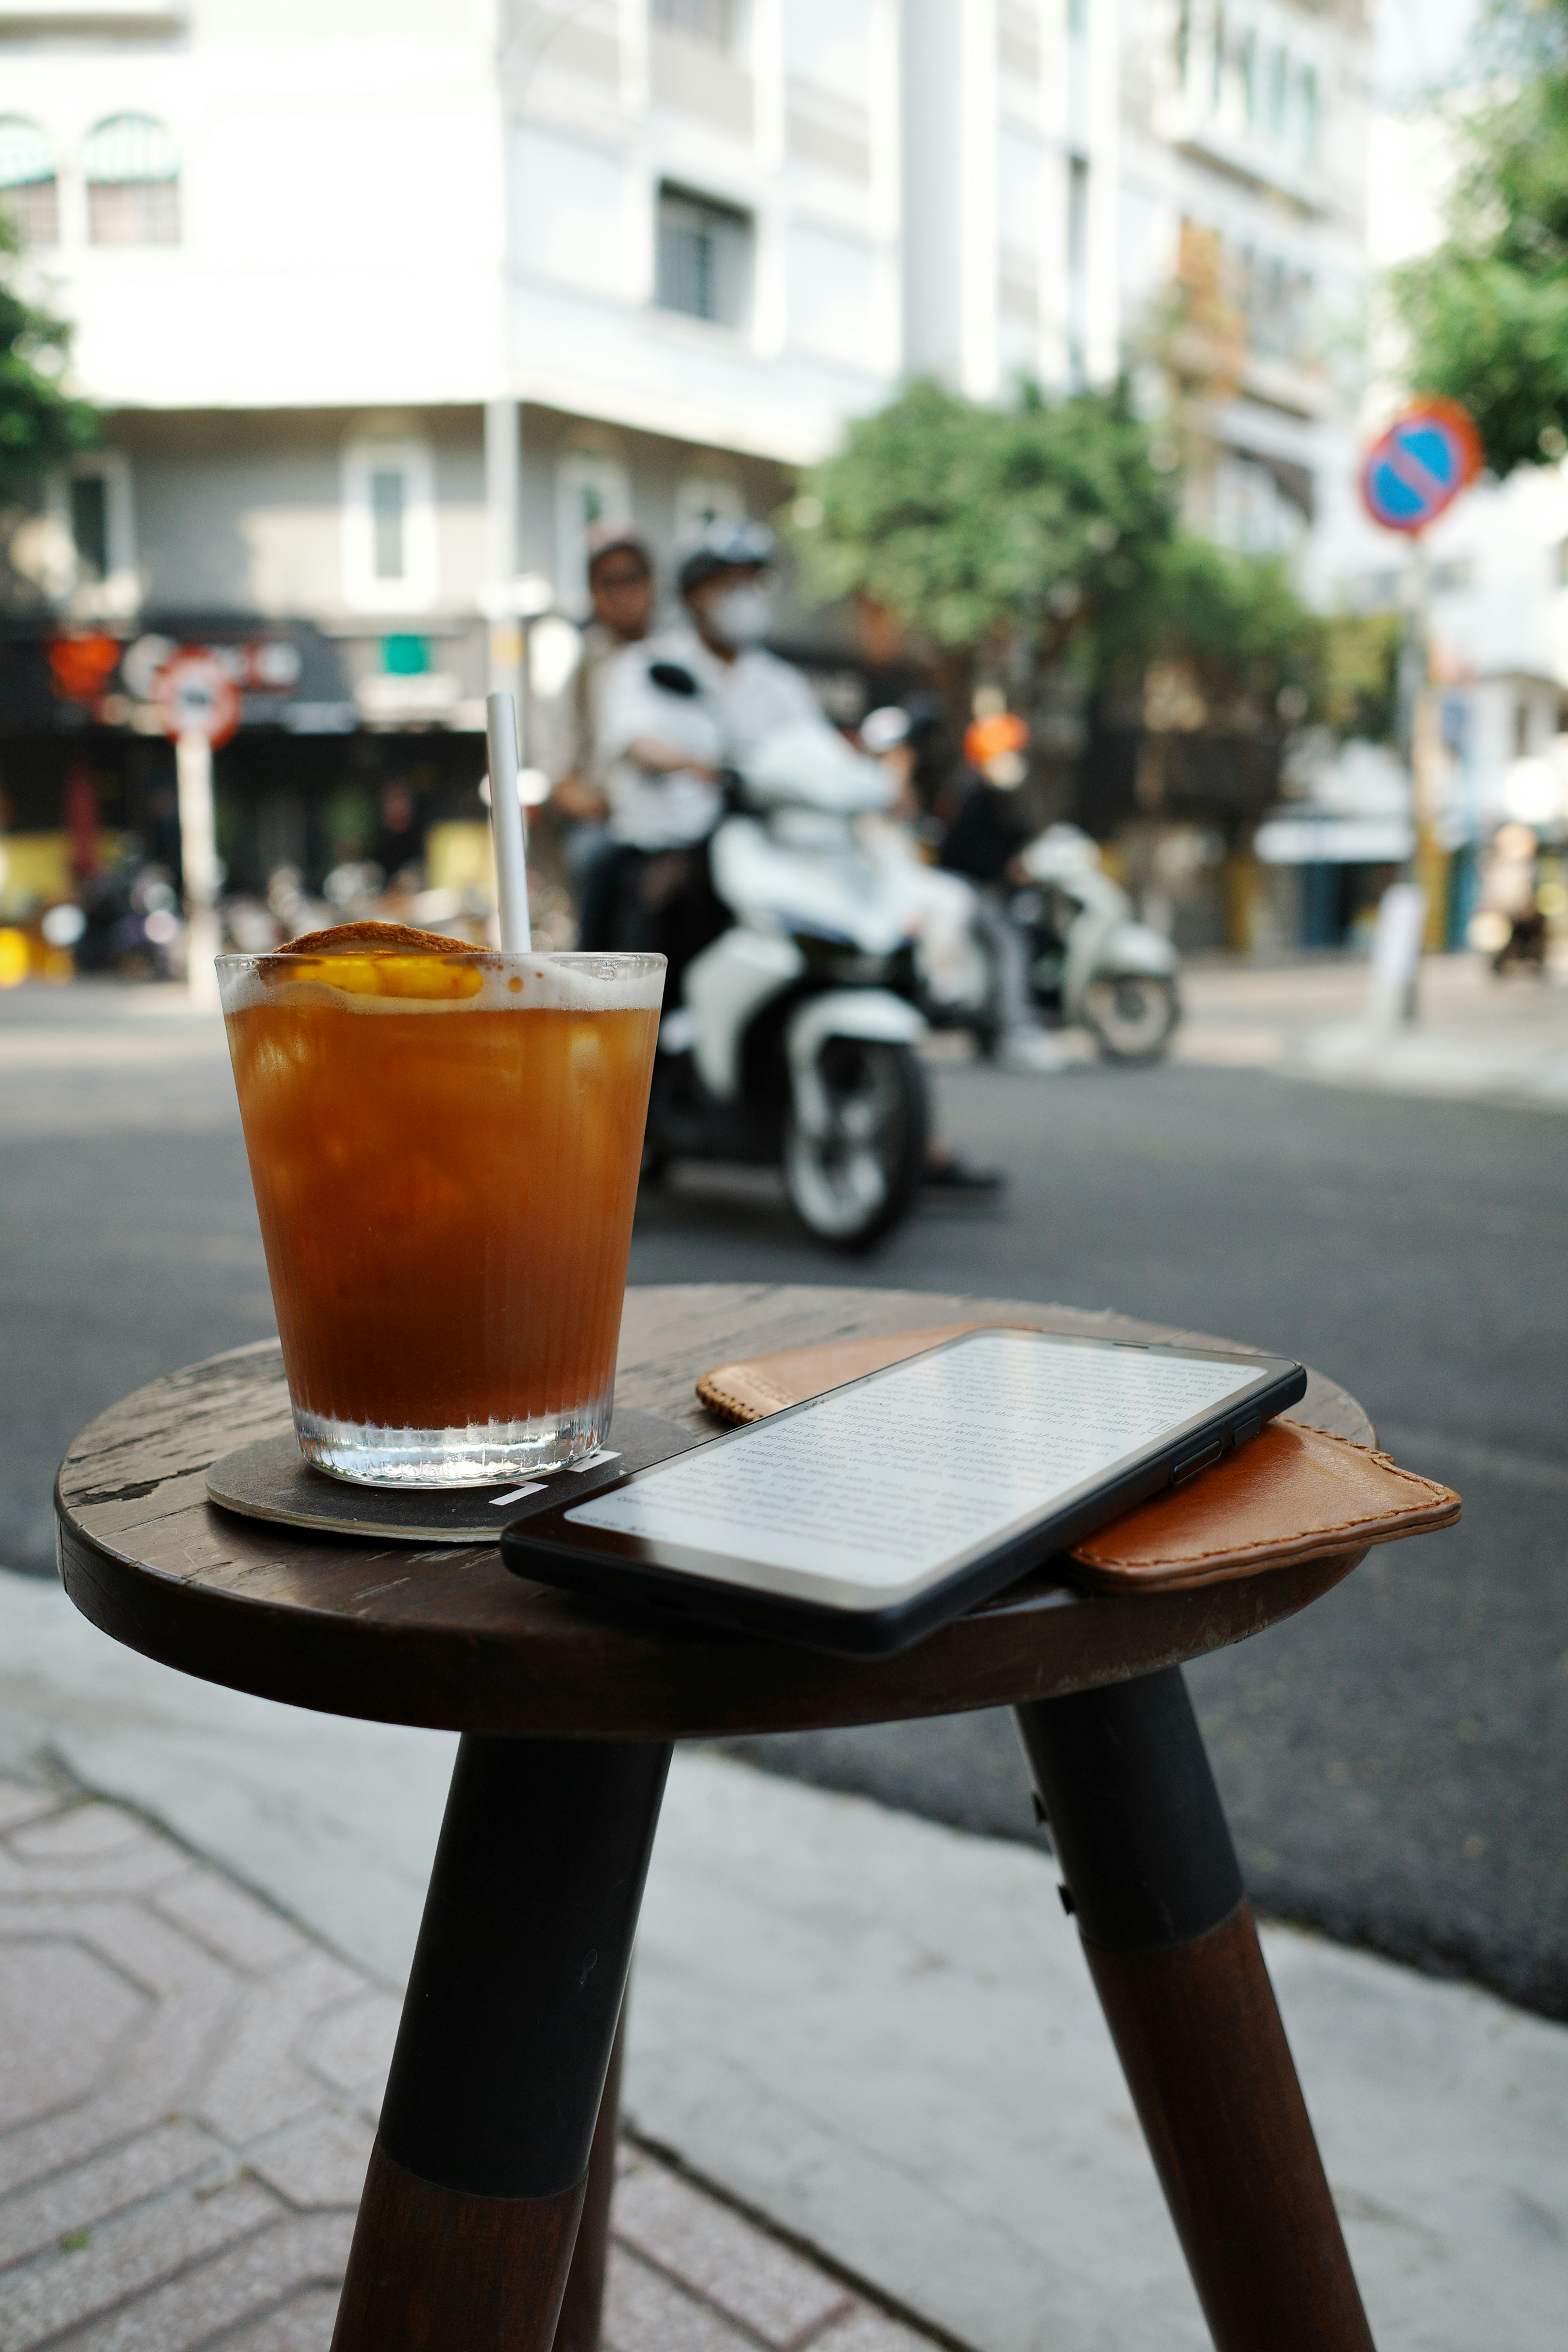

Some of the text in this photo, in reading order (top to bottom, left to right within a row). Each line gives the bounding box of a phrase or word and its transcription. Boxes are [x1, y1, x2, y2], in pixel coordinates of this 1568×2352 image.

[1062, 1385, 1129, 1394] ruminative
[1045, 1397, 1121, 1408] relationship
[1104, 1397, 1189, 1408] psychothera-
[843, 1414, 907, 1425] supervisor
[844, 1405, 895, 1414] Through
[957, 1423, 1018, 1433] generous
[1019, 1416, 1067, 1424] mother
[1082, 1424, 1135, 1434] thought
[762, 1436, 819, 1445] addiction
[806, 1416, 886, 1430] decades-long
[887, 1429, 942, 1438] recovery
[1001, 1446, 1051, 1455] alcohol
[812, 1451, 847, 1459] Steps
[867, 1442, 927, 1454] Although
[953, 1457, 1013, 1467] problem
[736, 1457, 784, 1466] worked
[797, 1458, 848, 1468] through
[685, 1467, 720, 1475] Steps
[771, 1473, 818, 1483] indeed
